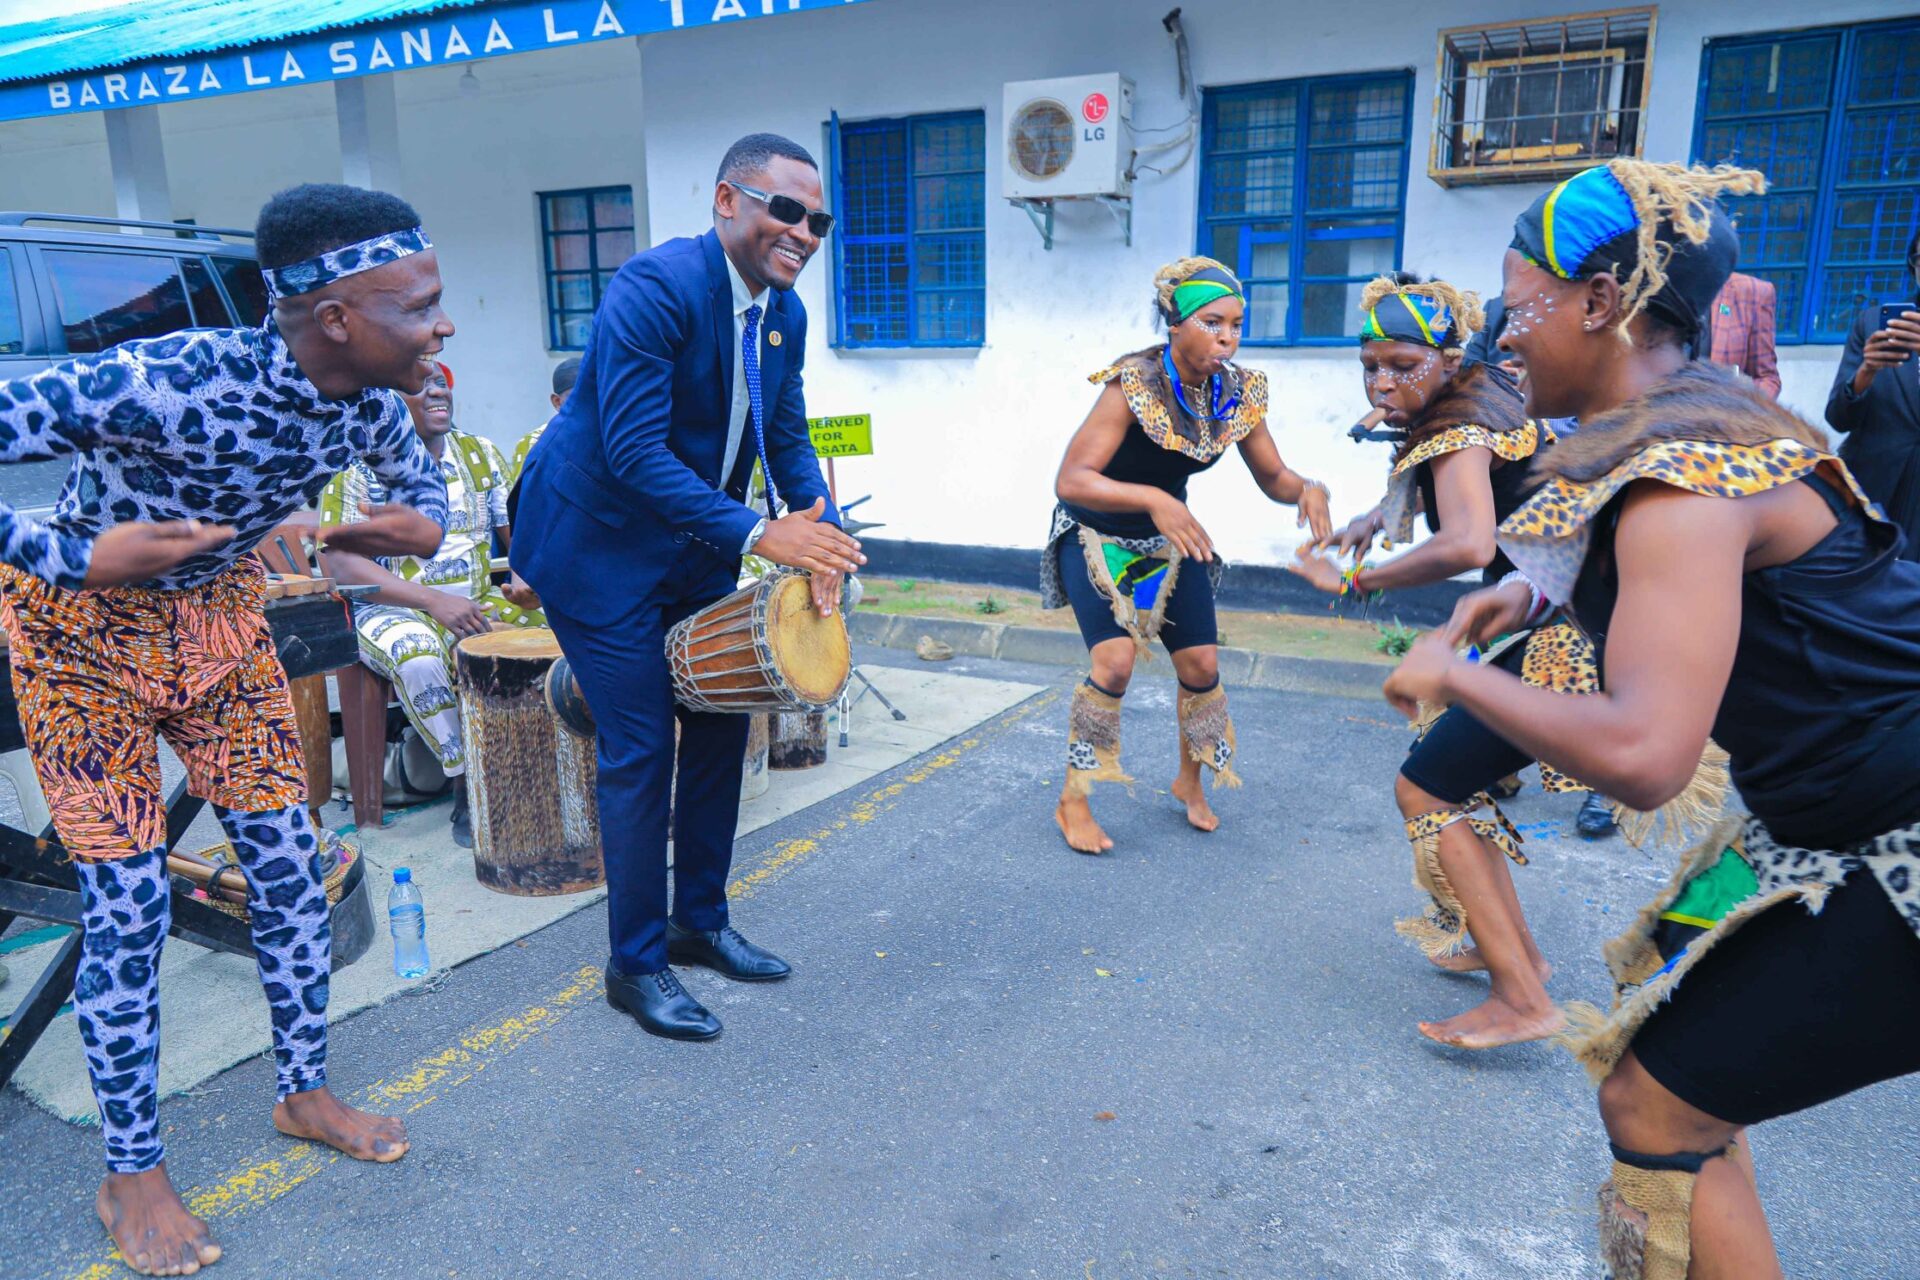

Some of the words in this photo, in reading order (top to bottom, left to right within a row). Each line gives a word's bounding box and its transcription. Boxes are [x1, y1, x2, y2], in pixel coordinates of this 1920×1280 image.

[48, 62, 222, 109] BARAZA
[242, 50, 305, 86] LA
[328, 17, 514, 75] SANAA
[543, 0, 625, 43] LA
[1084, 127, 1105, 142] LG
[814, 431, 843, 442] FOR
